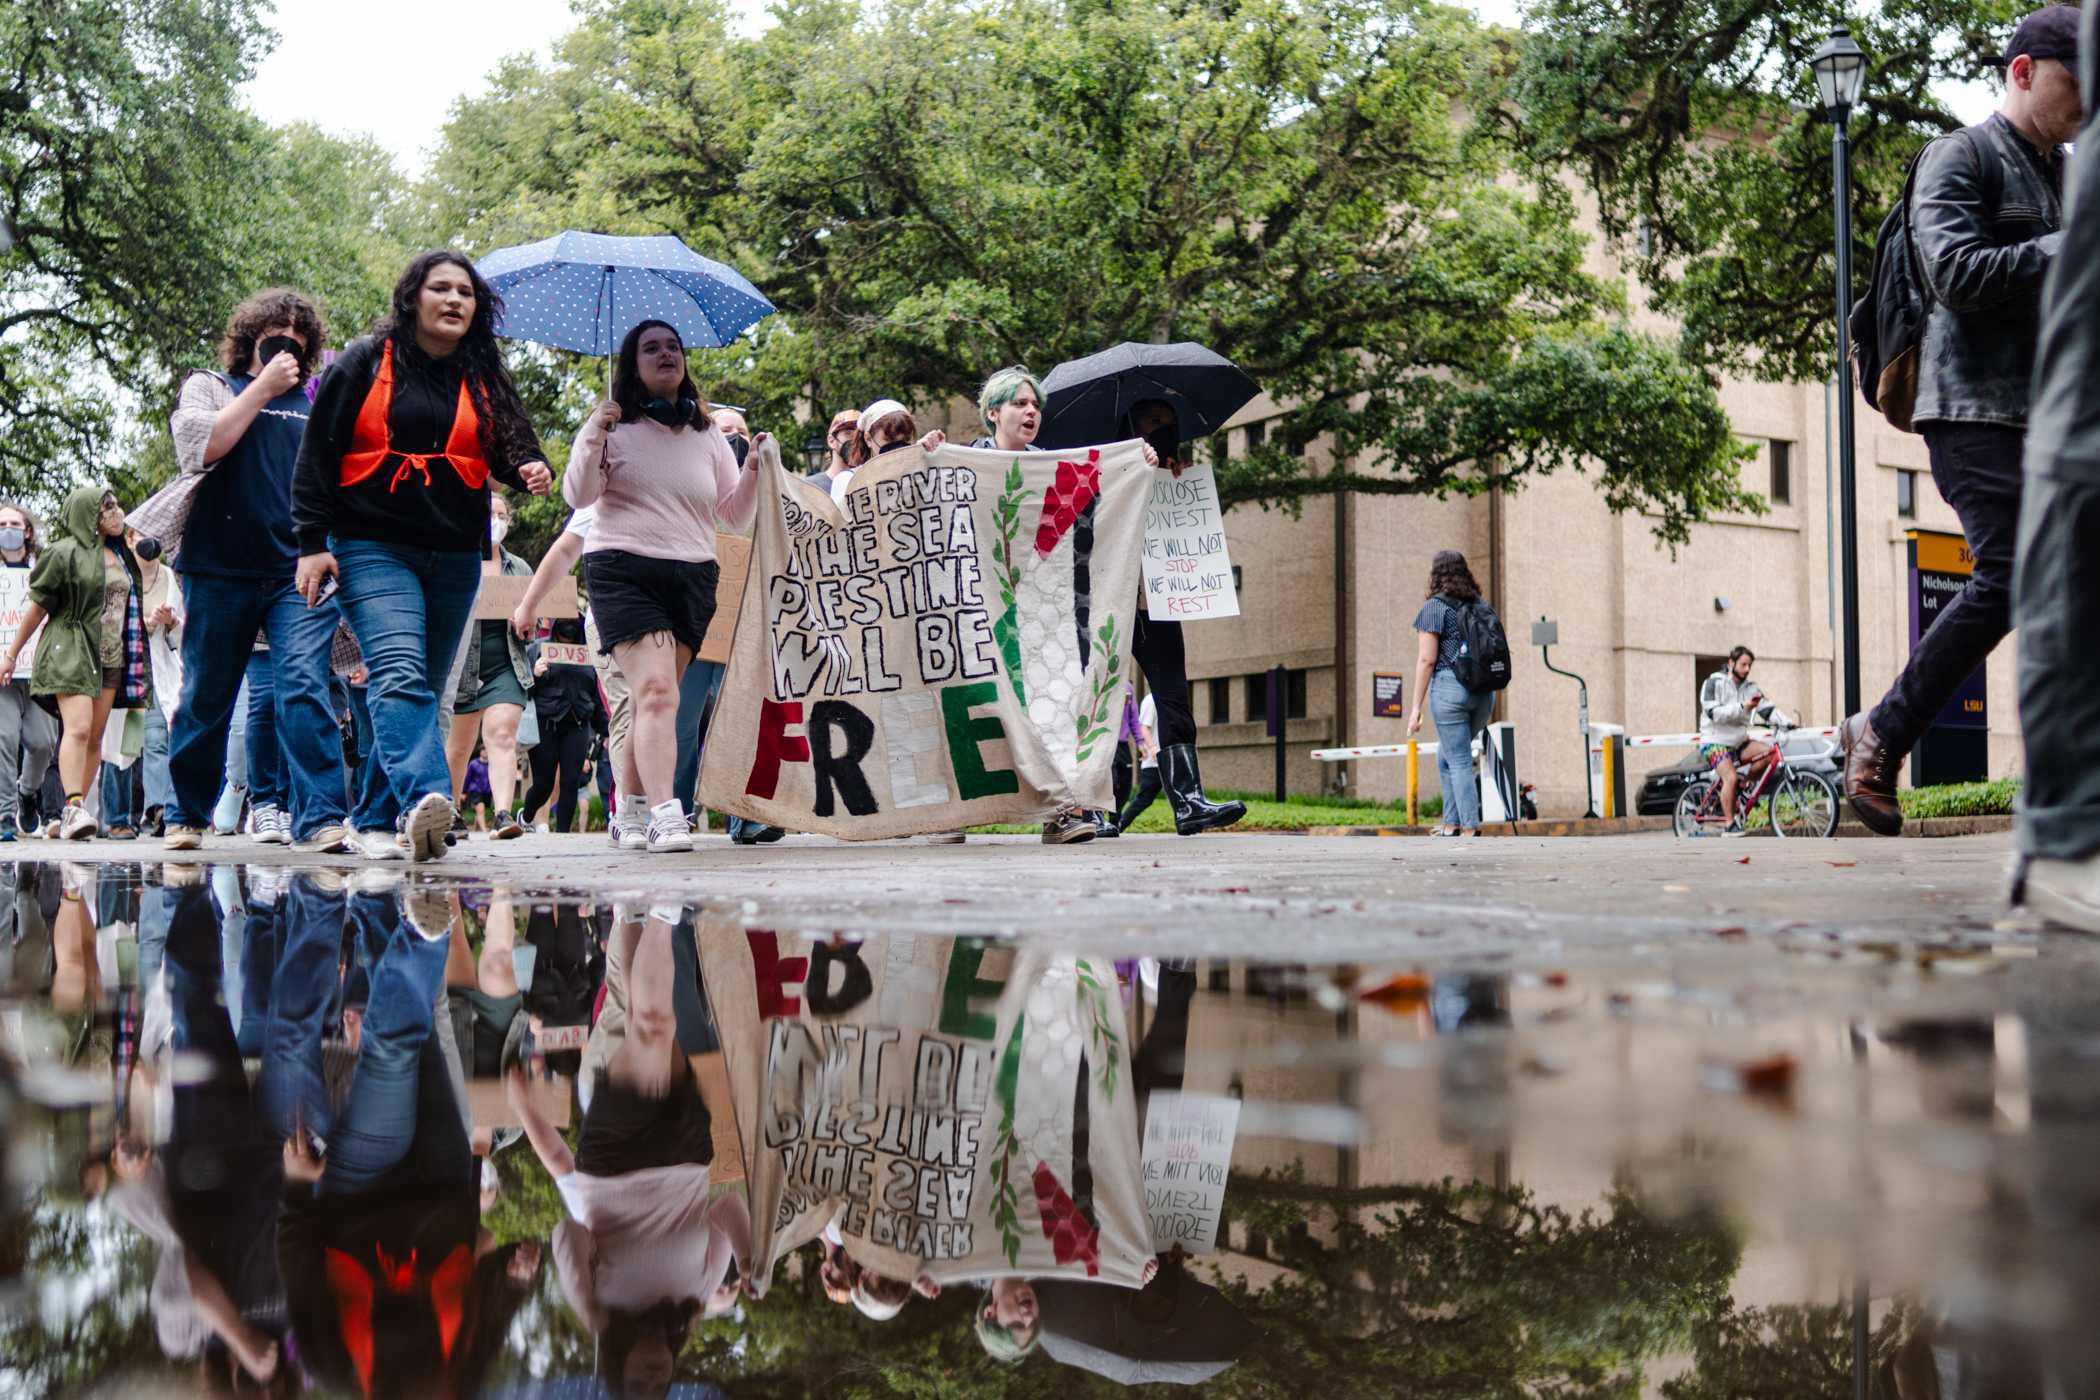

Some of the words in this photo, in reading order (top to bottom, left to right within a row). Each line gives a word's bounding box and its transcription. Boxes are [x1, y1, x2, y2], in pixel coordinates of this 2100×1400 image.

[875, 466, 978, 517] RIVER
[887, 503, 979, 562] SEA
[1162, 536, 1199, 558] WILL
[1198, 532, 1223, 556] NOT
[1165, 559, 1199, 574] STOP
[1147, 576, 1164, 594] WE
[1167, 576, 1199, 593] WILL
[1200, 573, 1227, 592] NOT
[1922, 575, 1966, 592] Nicholson
[1166, 594, 1219, 616] REST
[1922, 594, 1937, 609] Lot
[771, 626, 902, 701] WILL
[915, 608, 999, 685] BE
[1963, 698, 1984, 712] LSU
[745, 681, 1019, 817] FREE
